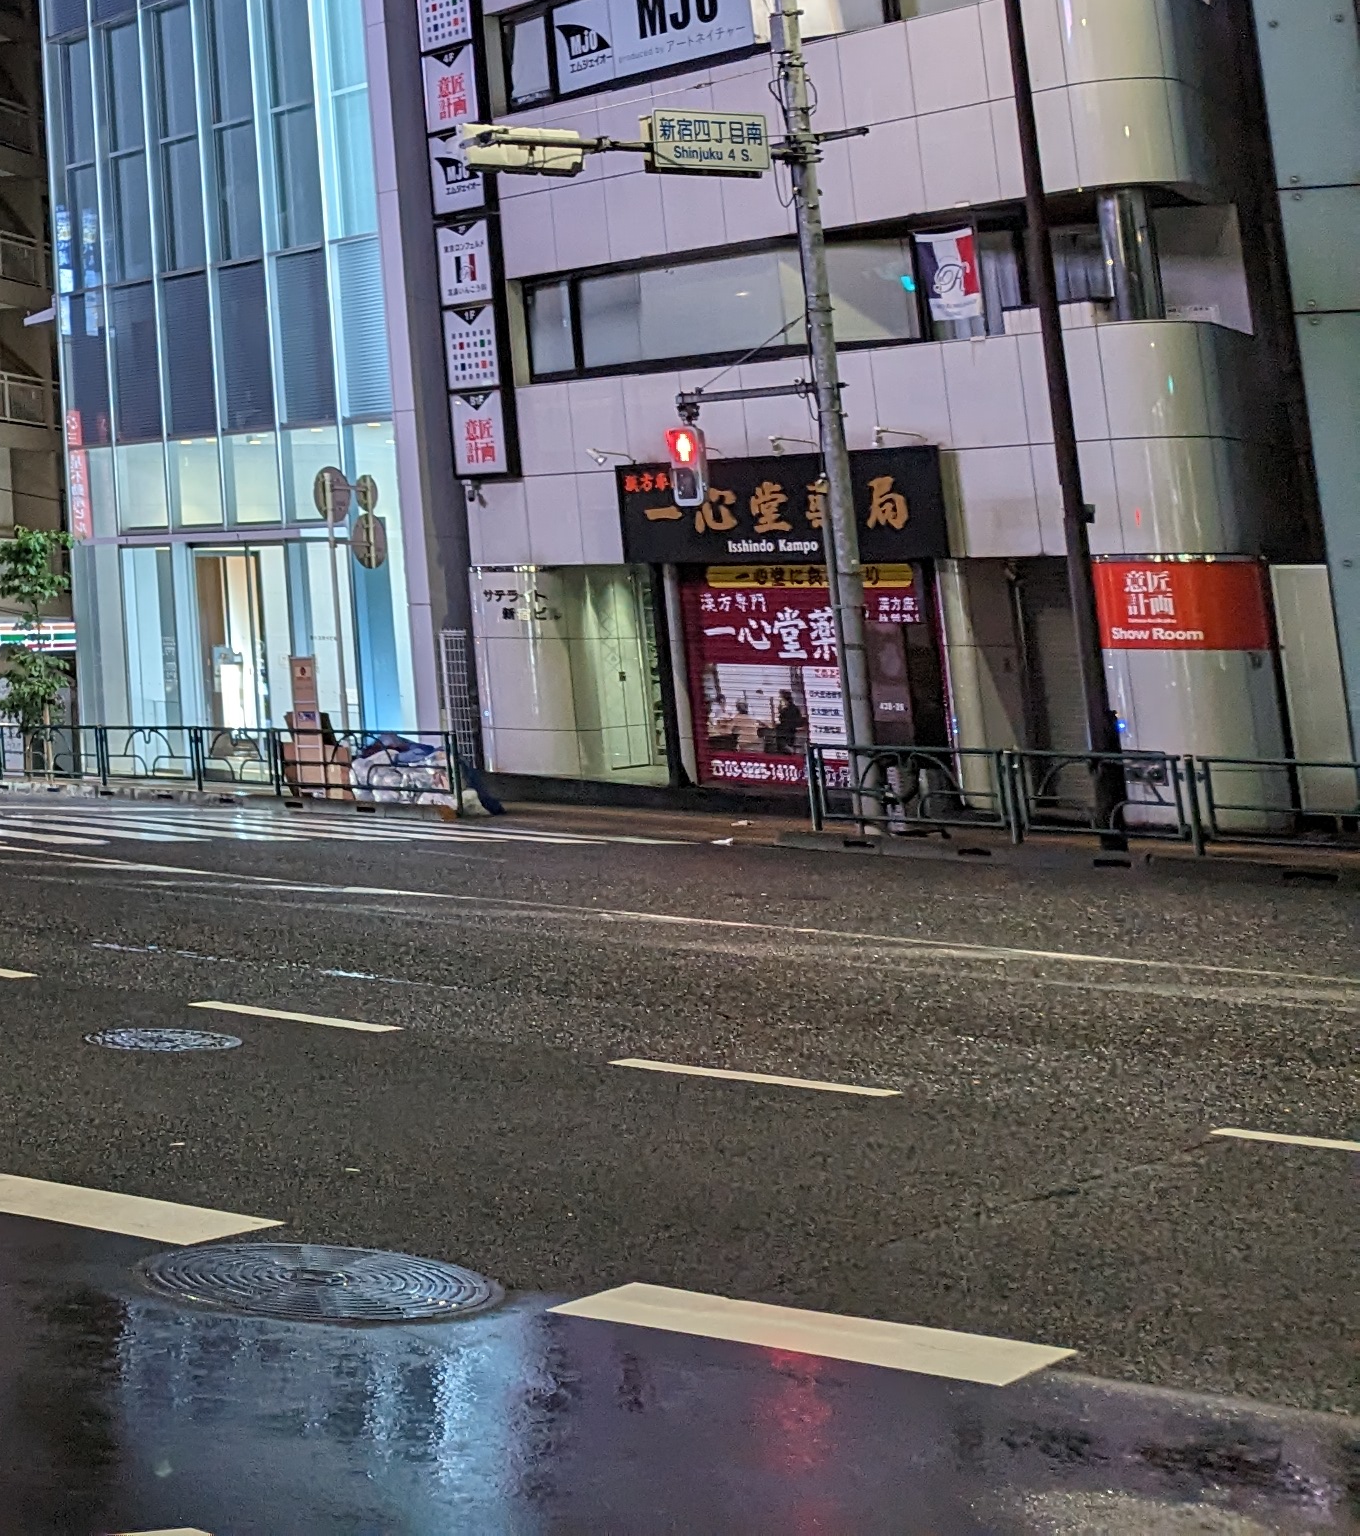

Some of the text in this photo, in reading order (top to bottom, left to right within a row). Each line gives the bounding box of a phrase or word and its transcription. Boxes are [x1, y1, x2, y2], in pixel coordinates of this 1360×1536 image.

[666, 26, 746, 53] アートネイチャー
[659, 117, 762, 146] 新宿四丁目南
[674, 145, 753, 162] Shinjuku 4 S.
[465, 417, 493, 441] 意匠
[466, 440, 496, 464] 計画
[727, 539, 818, 555] Isshindo Kampo
[1123, 570, 1173, 593] 意匠
[483, 588, 549, 603] サテライト
[1127, 593, 1175, 616] 計画
[1111, 627, 1204, 640] Show Room
